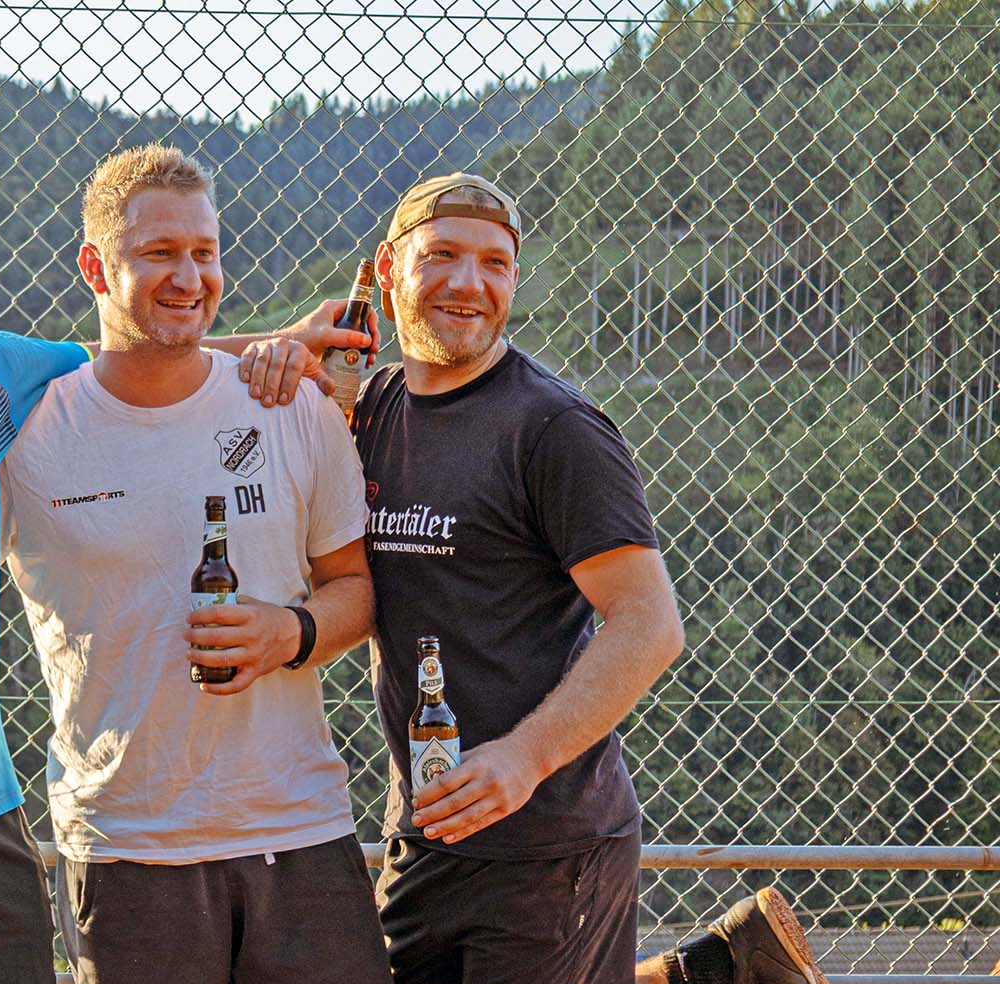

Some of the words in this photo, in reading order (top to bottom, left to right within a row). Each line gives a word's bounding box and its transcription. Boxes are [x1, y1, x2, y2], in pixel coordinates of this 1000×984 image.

[223, 430, 244, 456] ASV
[226, 435, 257, 469] NORDRACH
[234, 483, 266, 515] DH
[367, 504, 457, 540] ntertäler
